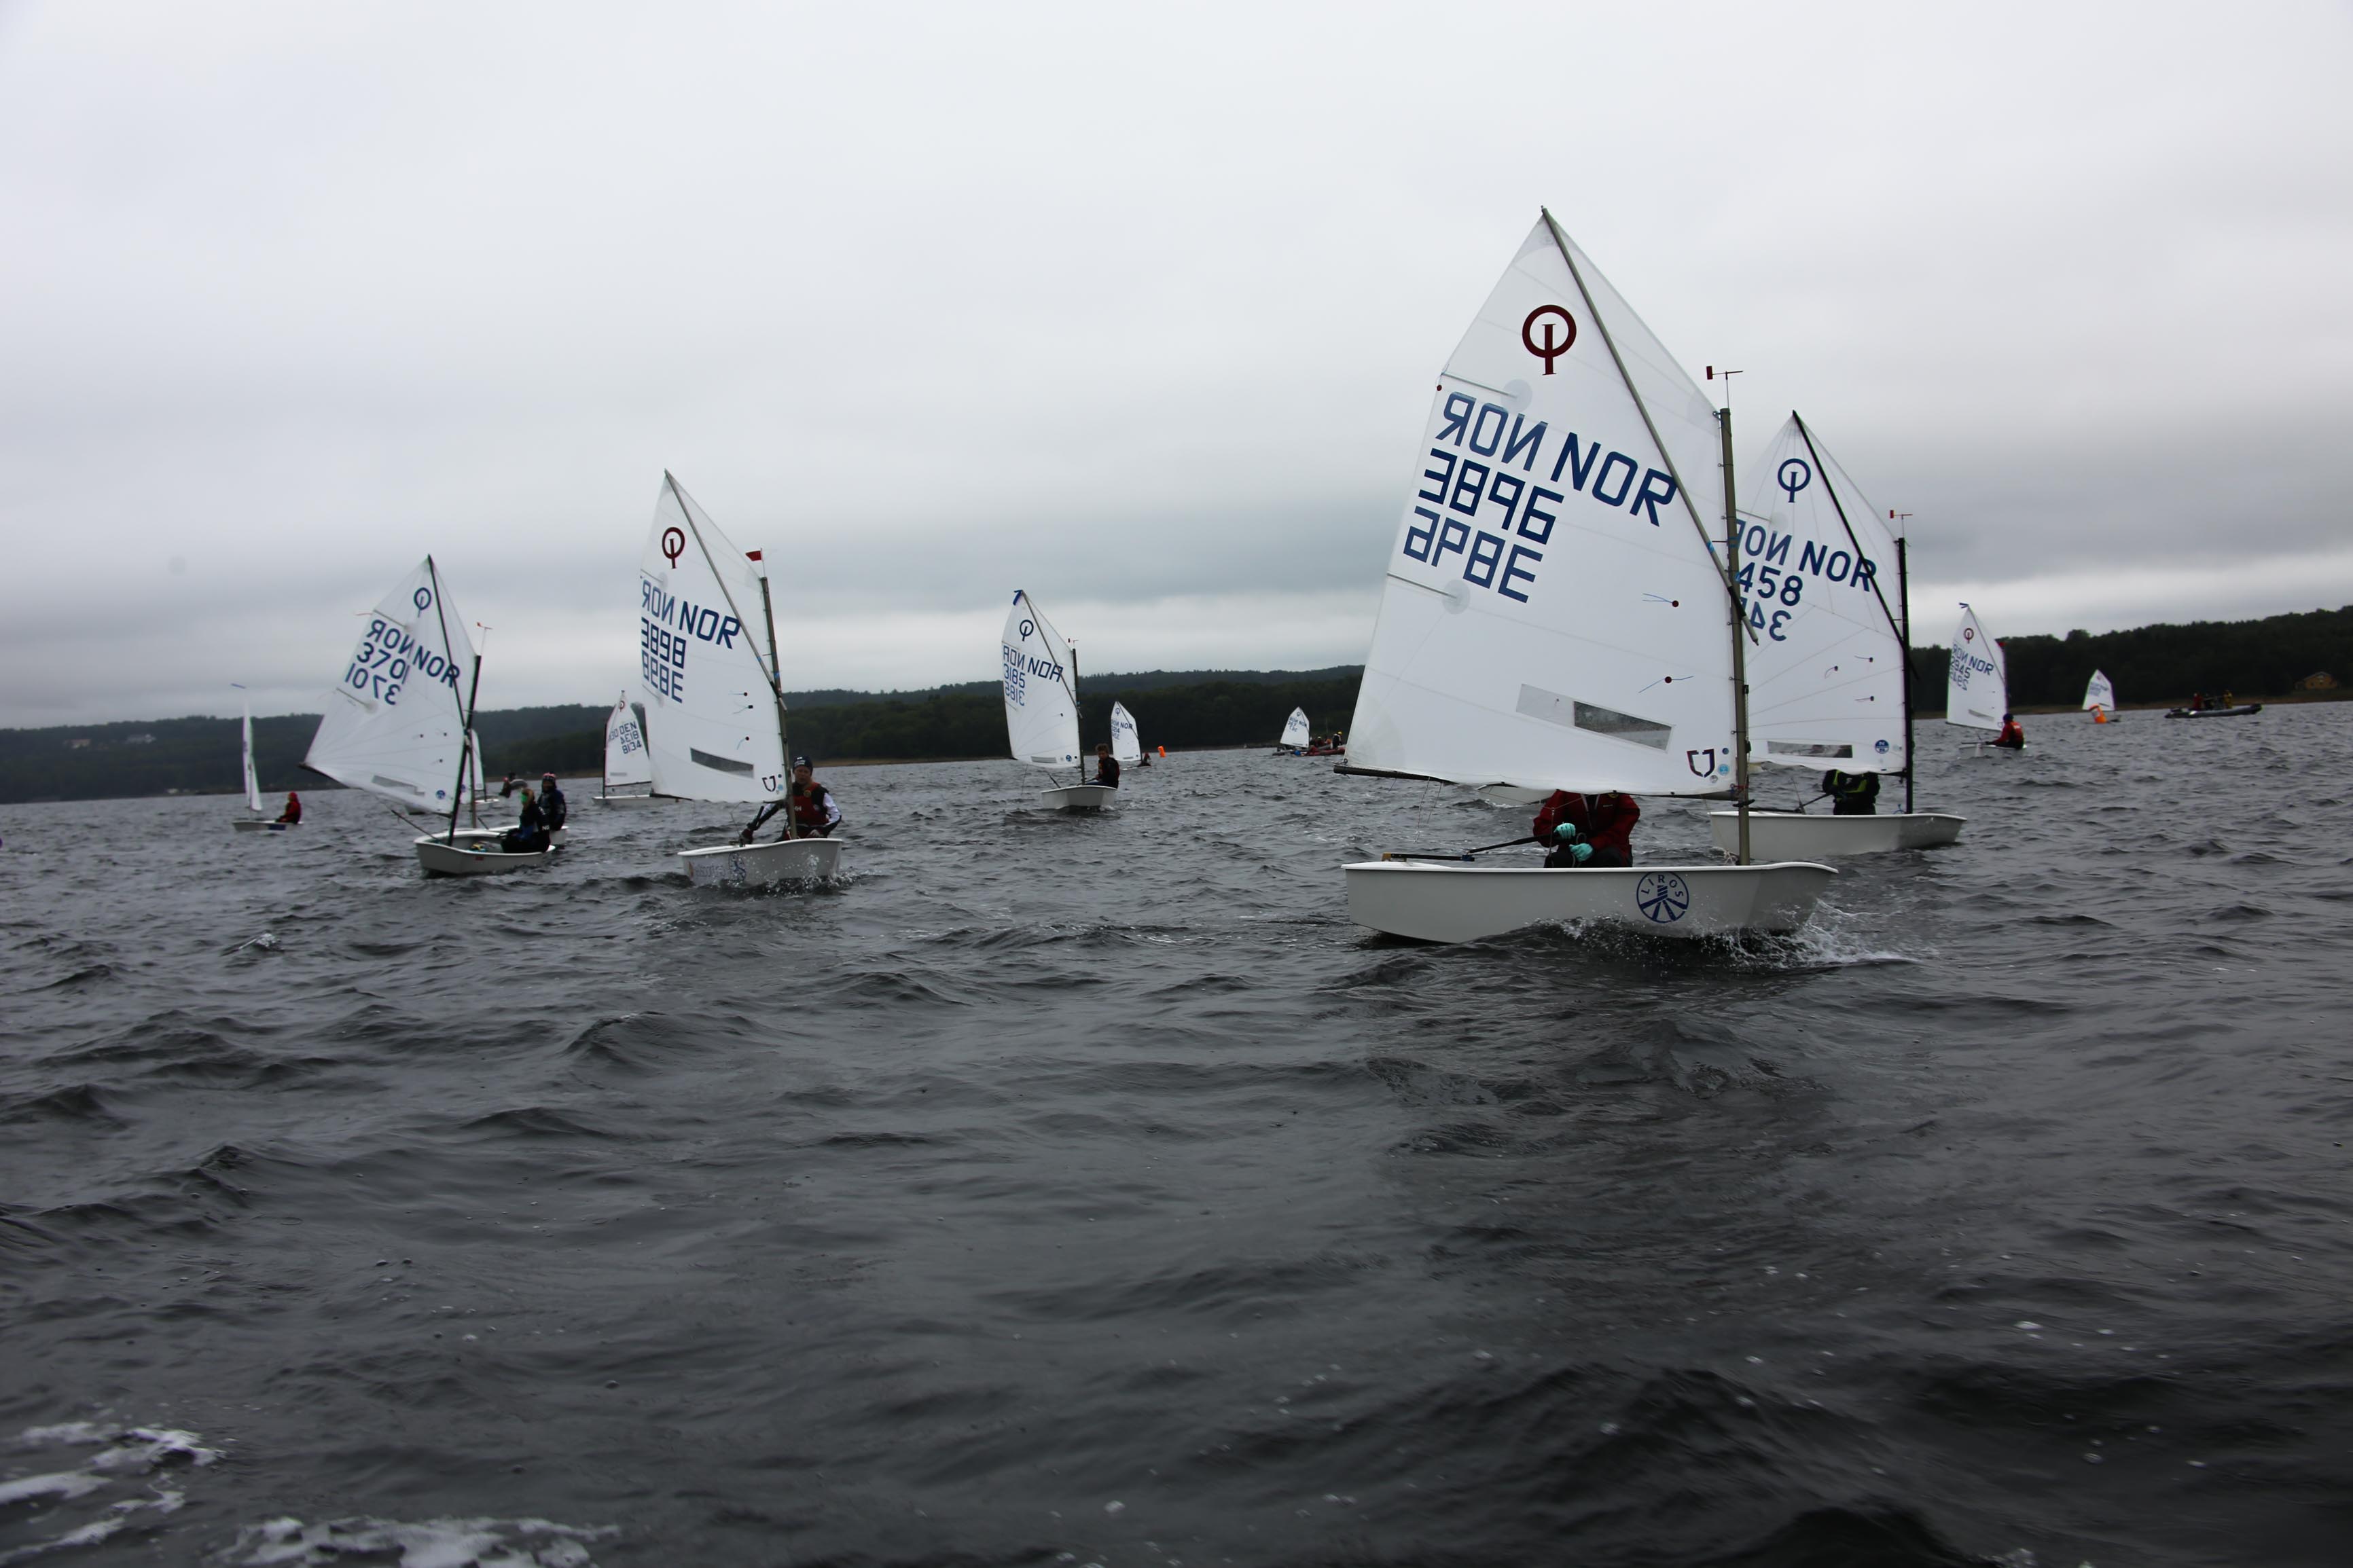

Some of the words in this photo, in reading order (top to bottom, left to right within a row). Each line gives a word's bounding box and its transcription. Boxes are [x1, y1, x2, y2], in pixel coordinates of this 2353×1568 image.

[1418, 448, 1565, 545] 3896
[1549, 432, 1678, 527] NOR
[1798, 540, 1877, 592] NOR
[641, 616, 687, 670] 3898
[679, 600, 742, 650] NOR
[412, 645, 461, 688] NOR
[1003, 663, 1026, 689] 3185
[1969, 655, 1994, 676] NOR
[619, 721, 637, 735] DEN
[622, 740, 642, 754] 8134
[1640, 874, 1684, 897] LIROS
